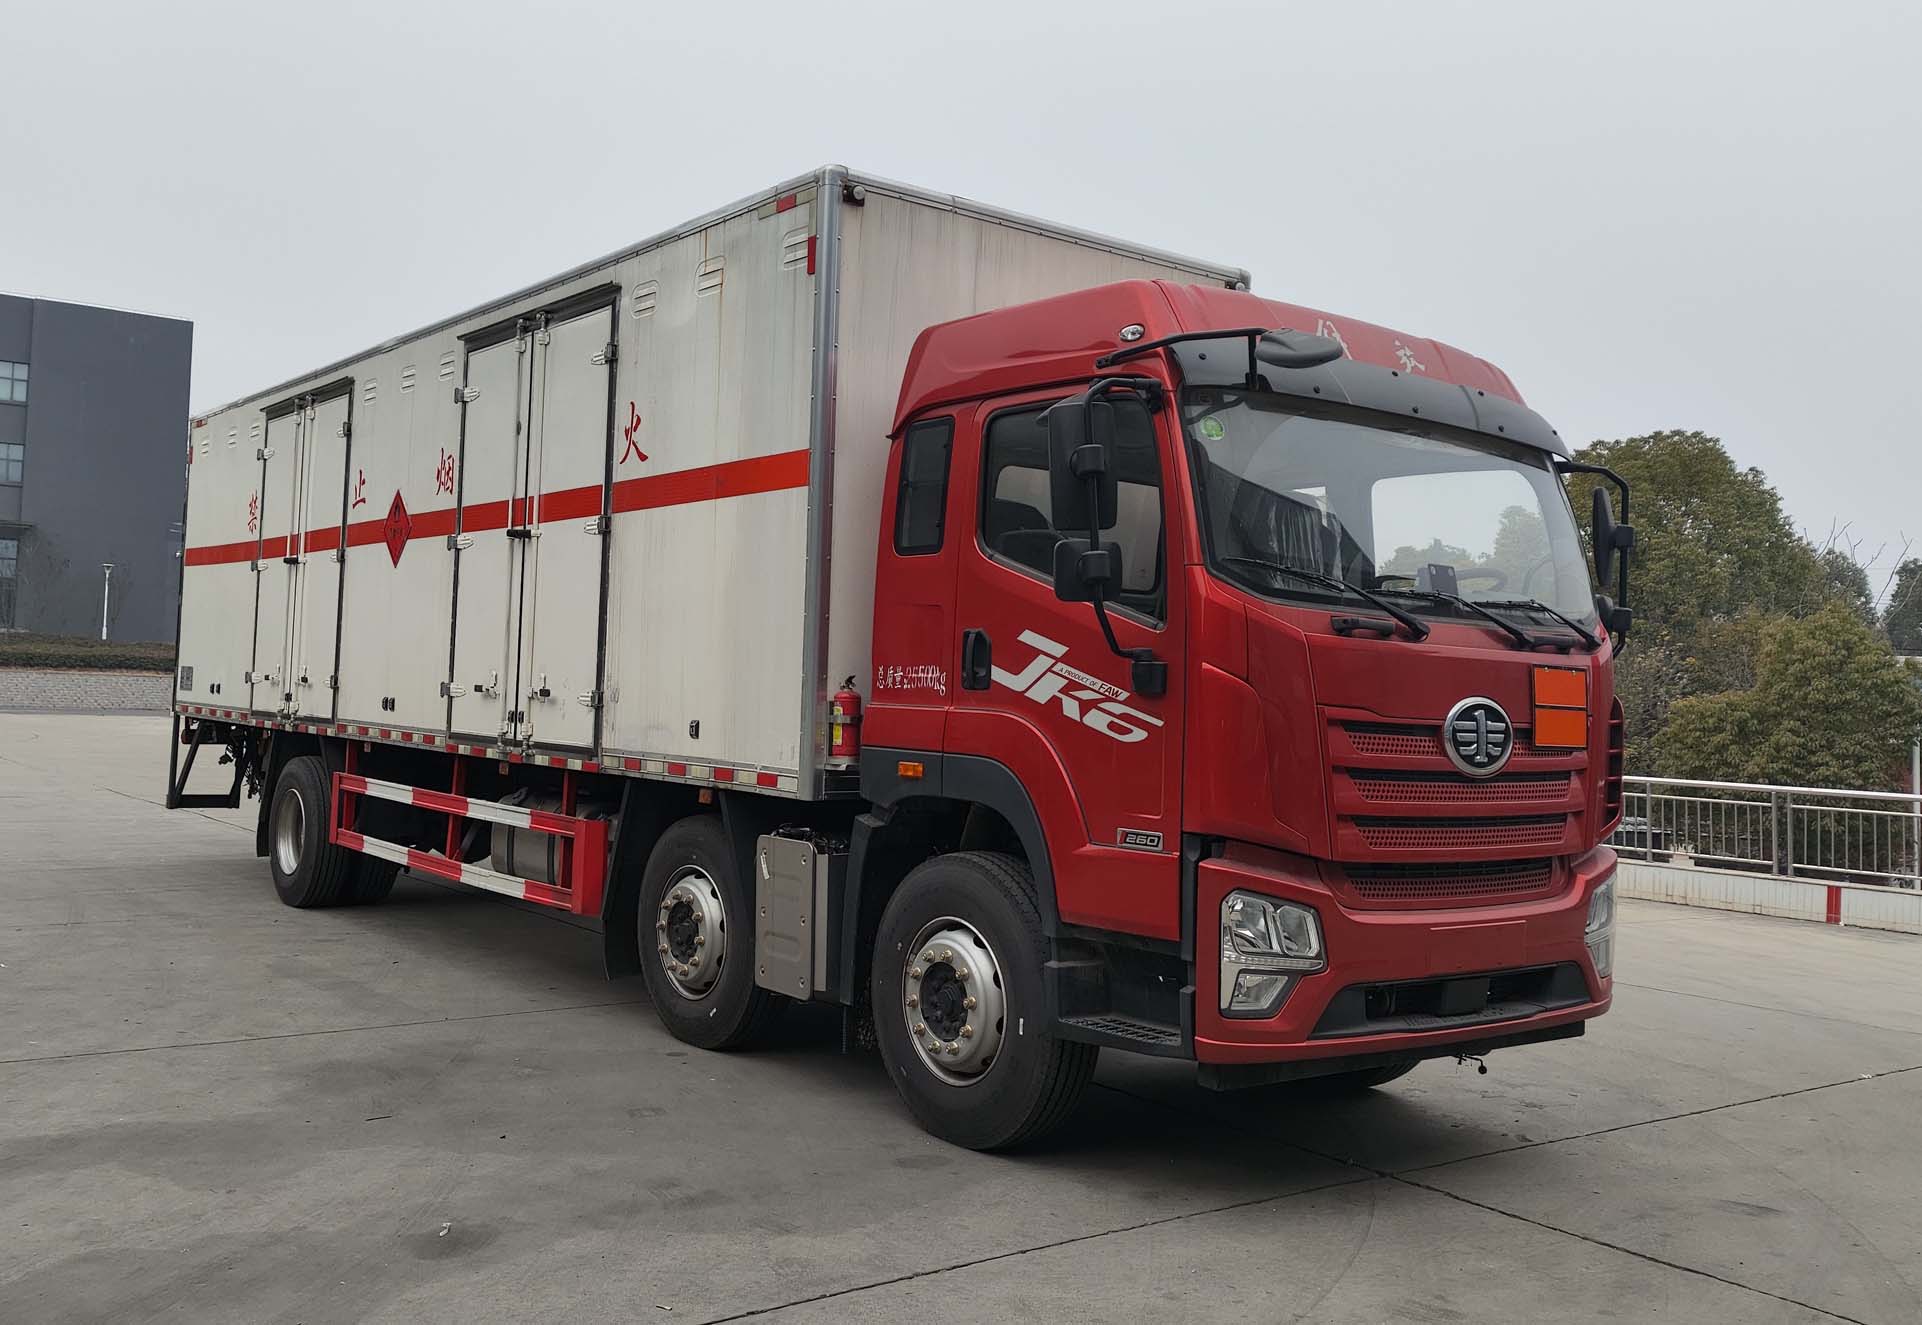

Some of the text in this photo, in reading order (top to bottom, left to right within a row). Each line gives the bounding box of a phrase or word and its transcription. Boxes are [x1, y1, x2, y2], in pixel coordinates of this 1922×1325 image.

[619, 401, 649, 465] 火
[1063, 669, 1090, 684] PRODUCT
[1089, 680, 1098, 688] OF
[1099, 683, 1124, 698] FAW
[1126, 833, 1159, 847] 260
